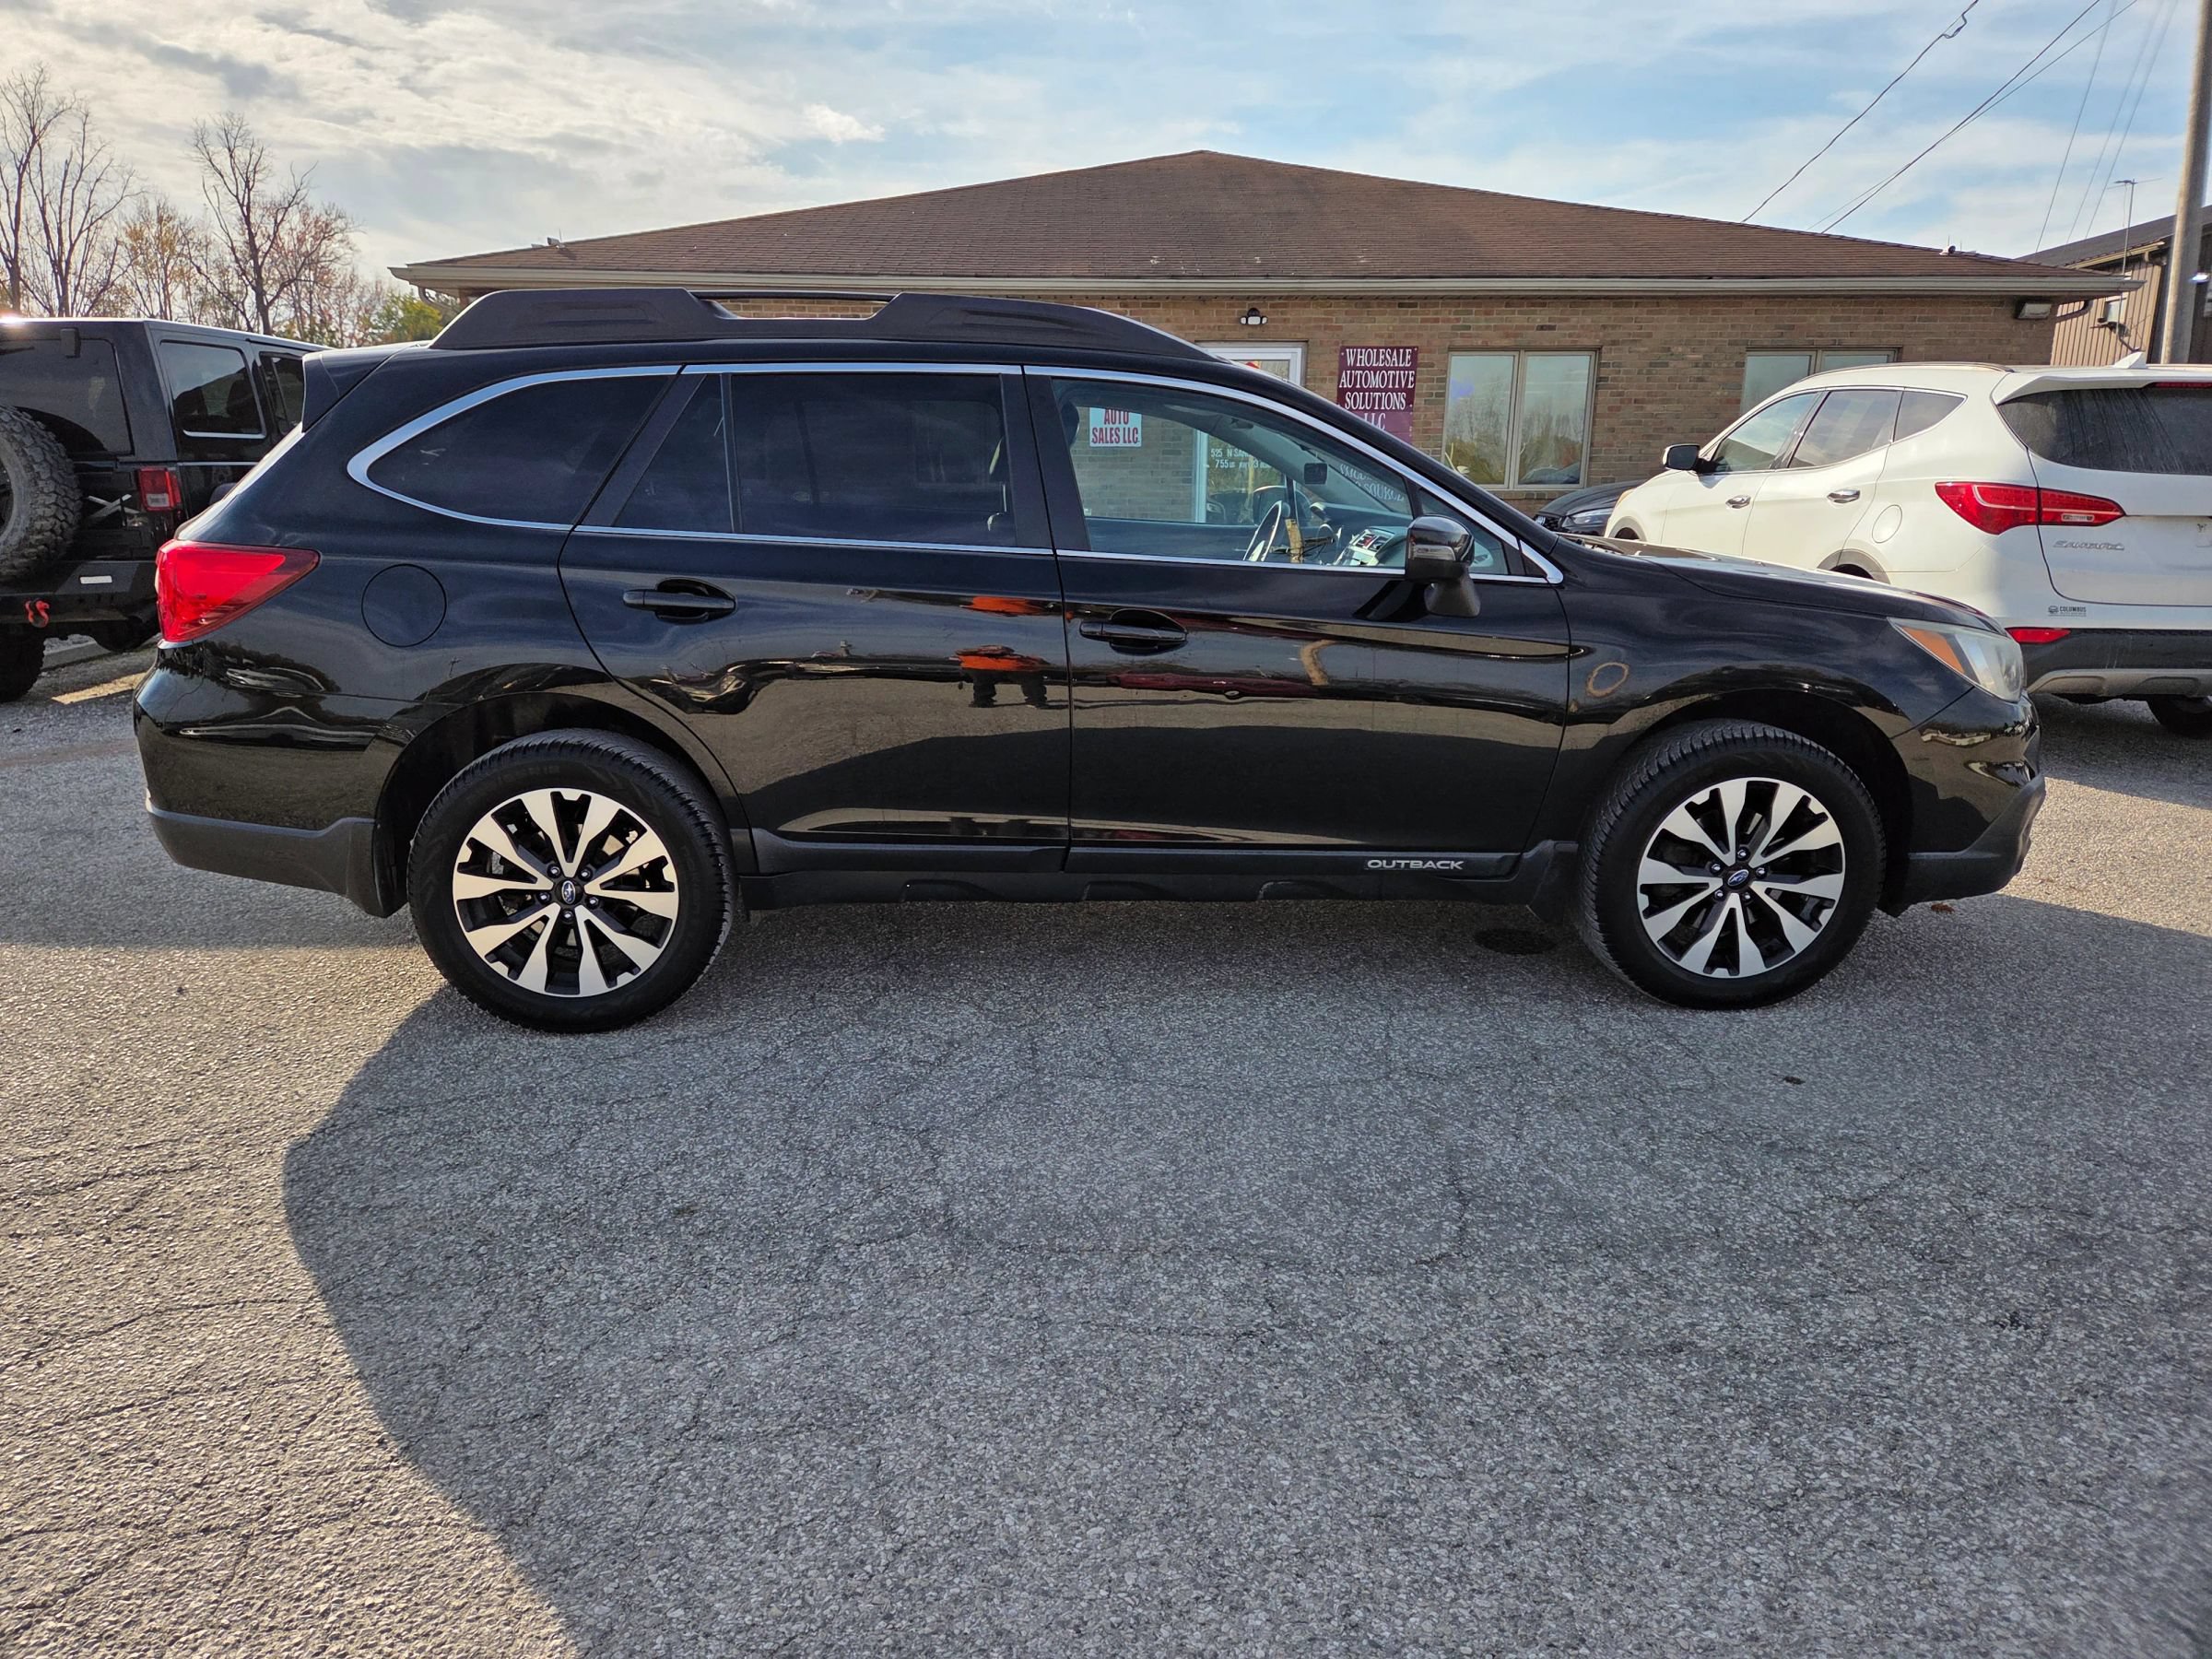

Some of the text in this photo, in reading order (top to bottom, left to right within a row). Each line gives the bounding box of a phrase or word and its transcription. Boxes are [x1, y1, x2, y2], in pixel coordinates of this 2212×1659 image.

[1346, 348, 1412, 367] WHOLESALE
[1339, 371, 1415, 389] AUTOMOTIVE
[1345, 392, 1406, 410] SOLUTIONS
[1103, 408, 1129, 425] AUTO
[1091, 427, 1139, 444] SALES LLC
[1367, 859, 1465, 870] OUTBACK
